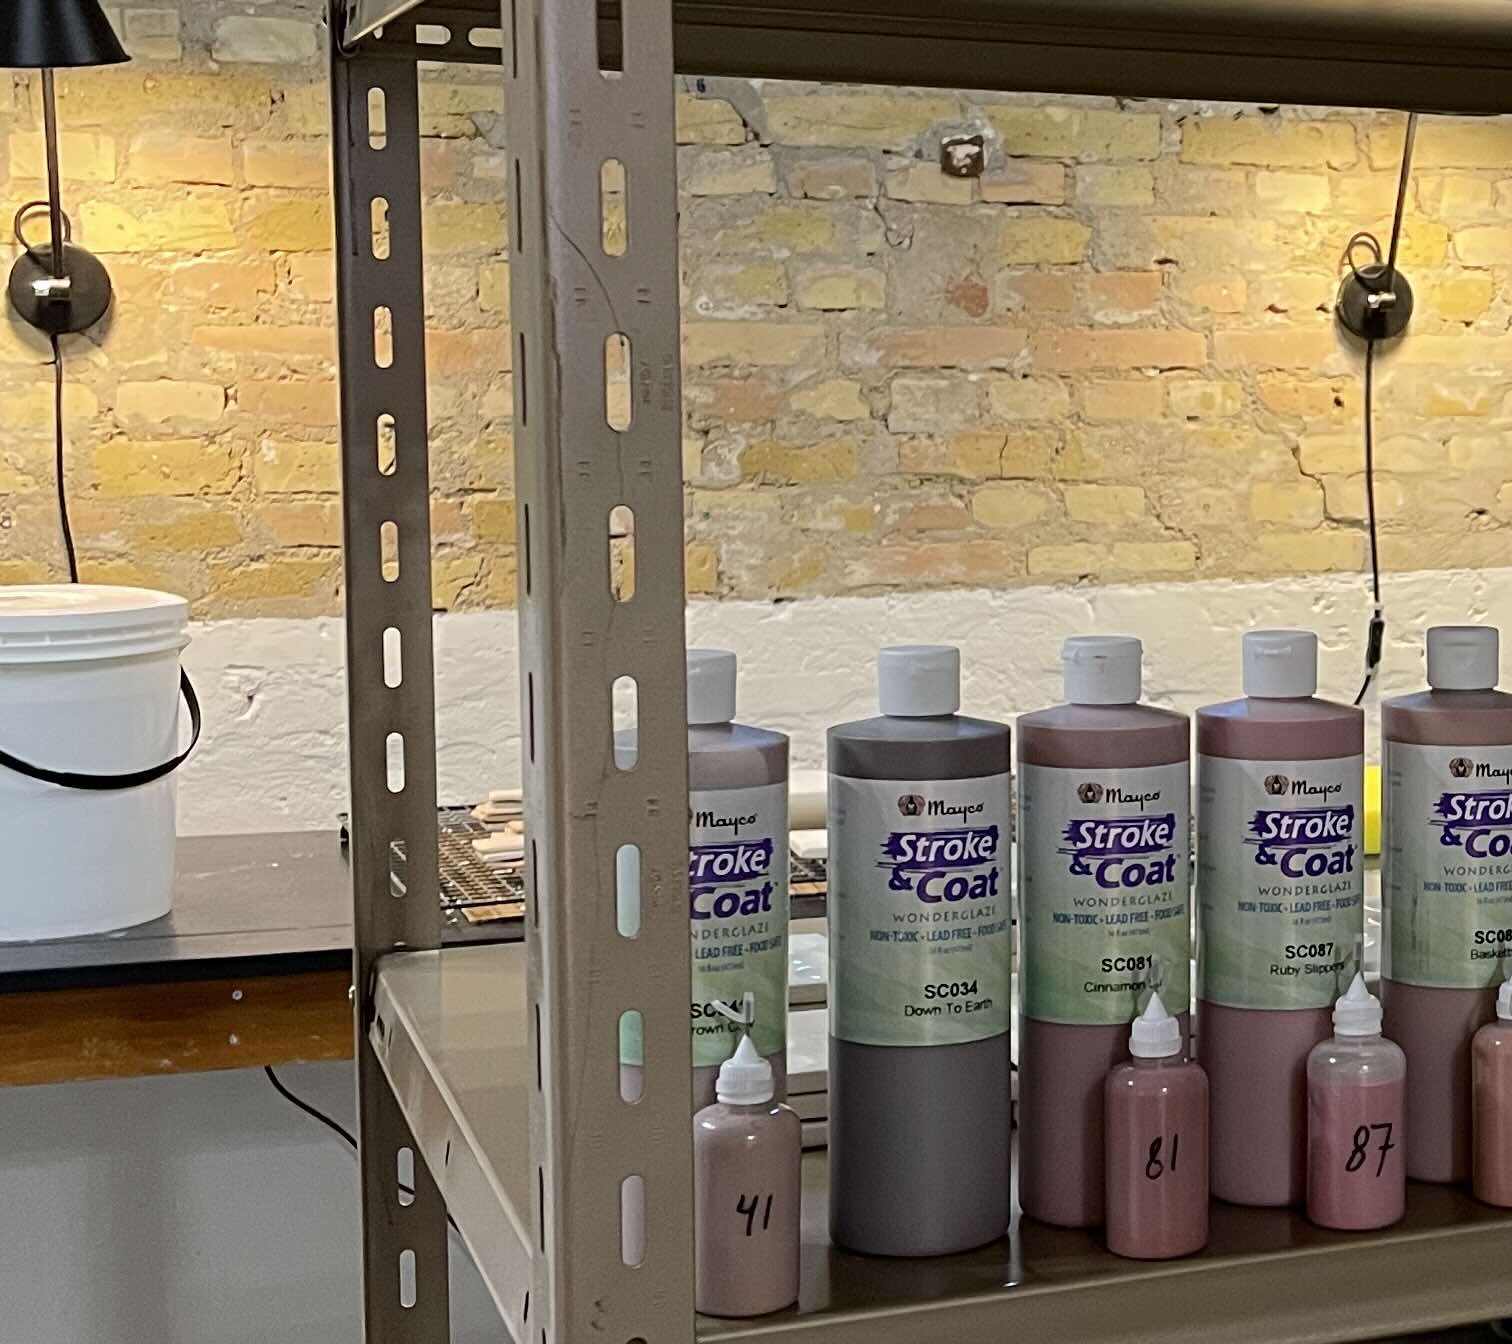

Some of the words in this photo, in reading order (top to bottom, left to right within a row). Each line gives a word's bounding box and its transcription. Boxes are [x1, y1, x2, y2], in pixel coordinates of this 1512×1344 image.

[1105, 787, 1160, 812] Mayco
[1290, 779, 1342, 803] Mayco
[695, 811, 757, 836] Mayco
[927, 800, 985, 824] Mayco
[1075, 819, 1170, 852] Stroke
[1262, 811, 1349, 841] Stroke
[1440, 827, 1462, 847] &
[895, 832, 995, 864] Stroke
[1069, 853, 1093, 876] &
[1095, 853, 1177, 889] Coat
[1254, 844, 1278, 867] &
[1280, 844, 1355, 878] Coat
[888, 868, 914, 891] &
[916, 867, 1000, 903] Coat
[1101, 955, 1153, 973] SC081
[1285, 943, 1335, 961] SC087
[1269, 964, 1301, 977] Ruby
[923, 980, 978, 1000] SC034
[1084, 979, 1146, 994] Cinnamon
[904, 1003, 942, 1018] Down
[946, 1002, 963, 1015] To
[965, 997, 993, 1014] Earth
[1145, 1134, 1178, 1181] 81
[1344, 1122, 1395, 1176] 87
[736, 1192, 773, 1237] 41
